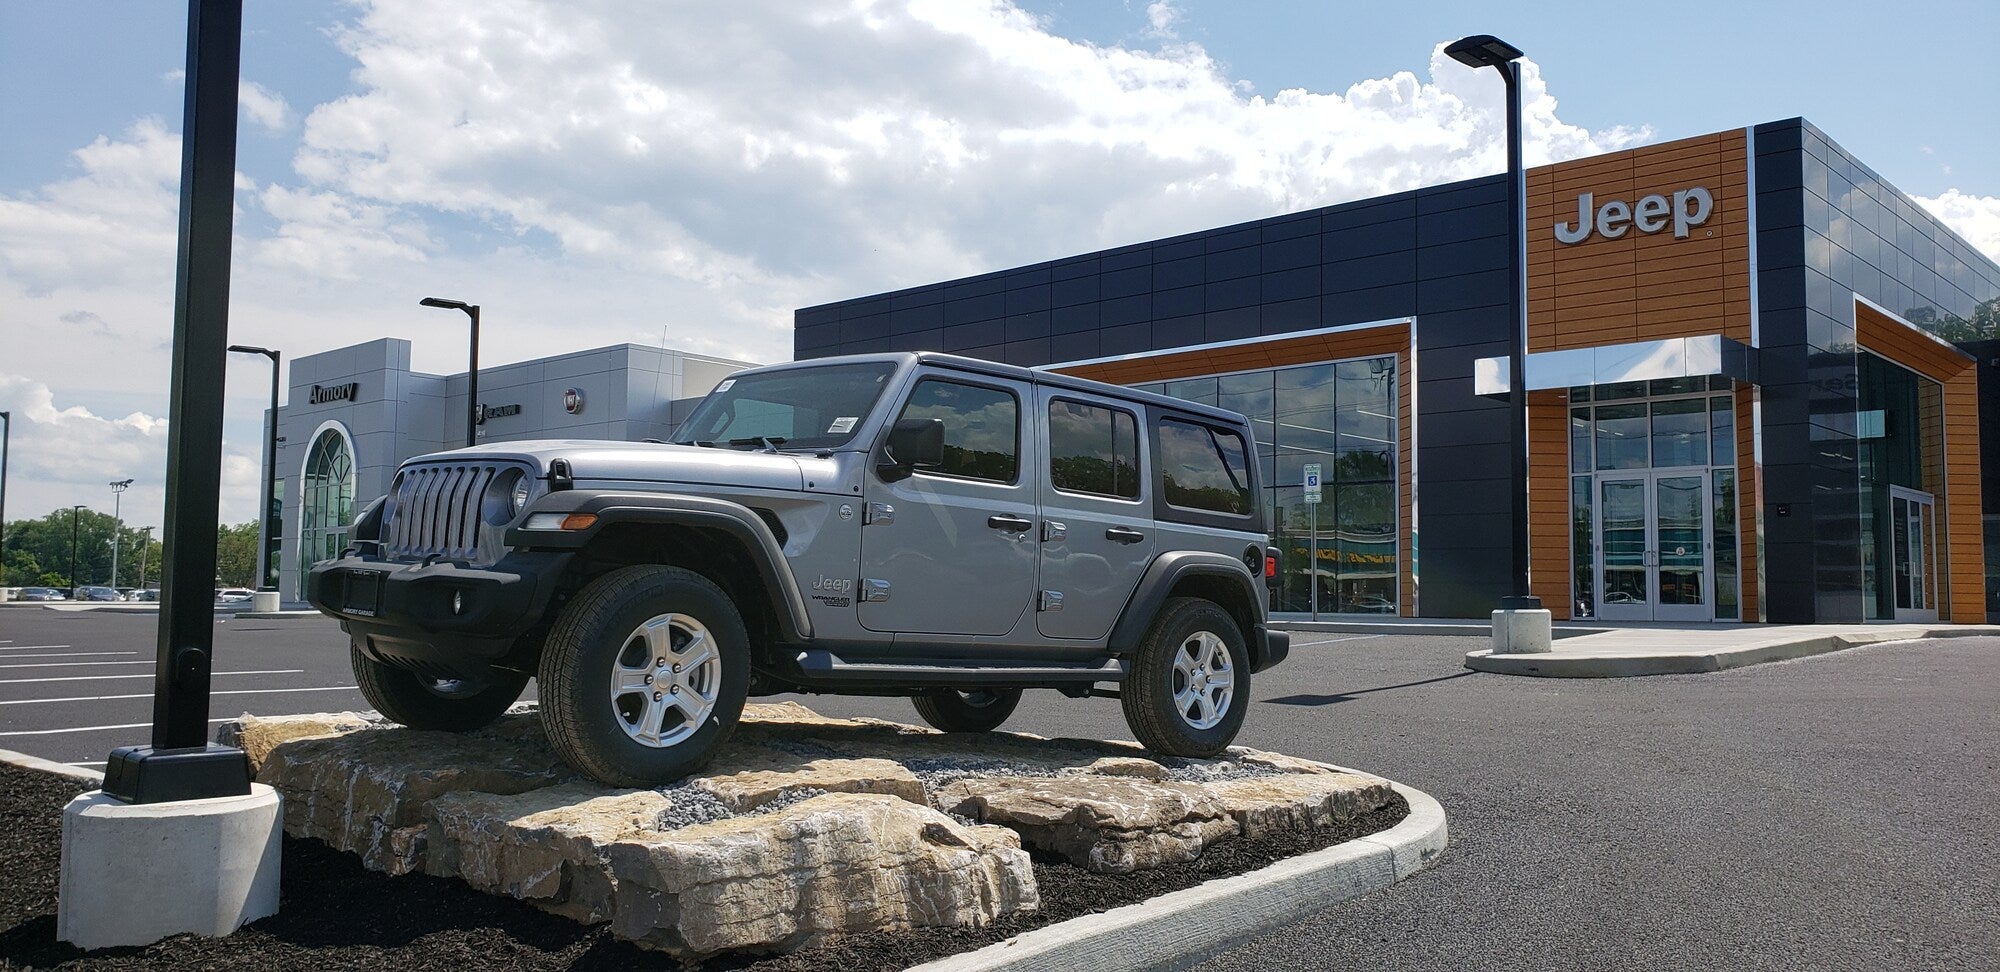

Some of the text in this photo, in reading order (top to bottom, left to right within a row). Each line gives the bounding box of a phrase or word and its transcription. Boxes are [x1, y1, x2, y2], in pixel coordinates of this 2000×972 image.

[1554, 186, 1714, 245] Jeep
[309, 382, 356, 404] Armory
[812, 574, 851, 594] Jeep
[811, 594, 850, 602] WRANGLER
